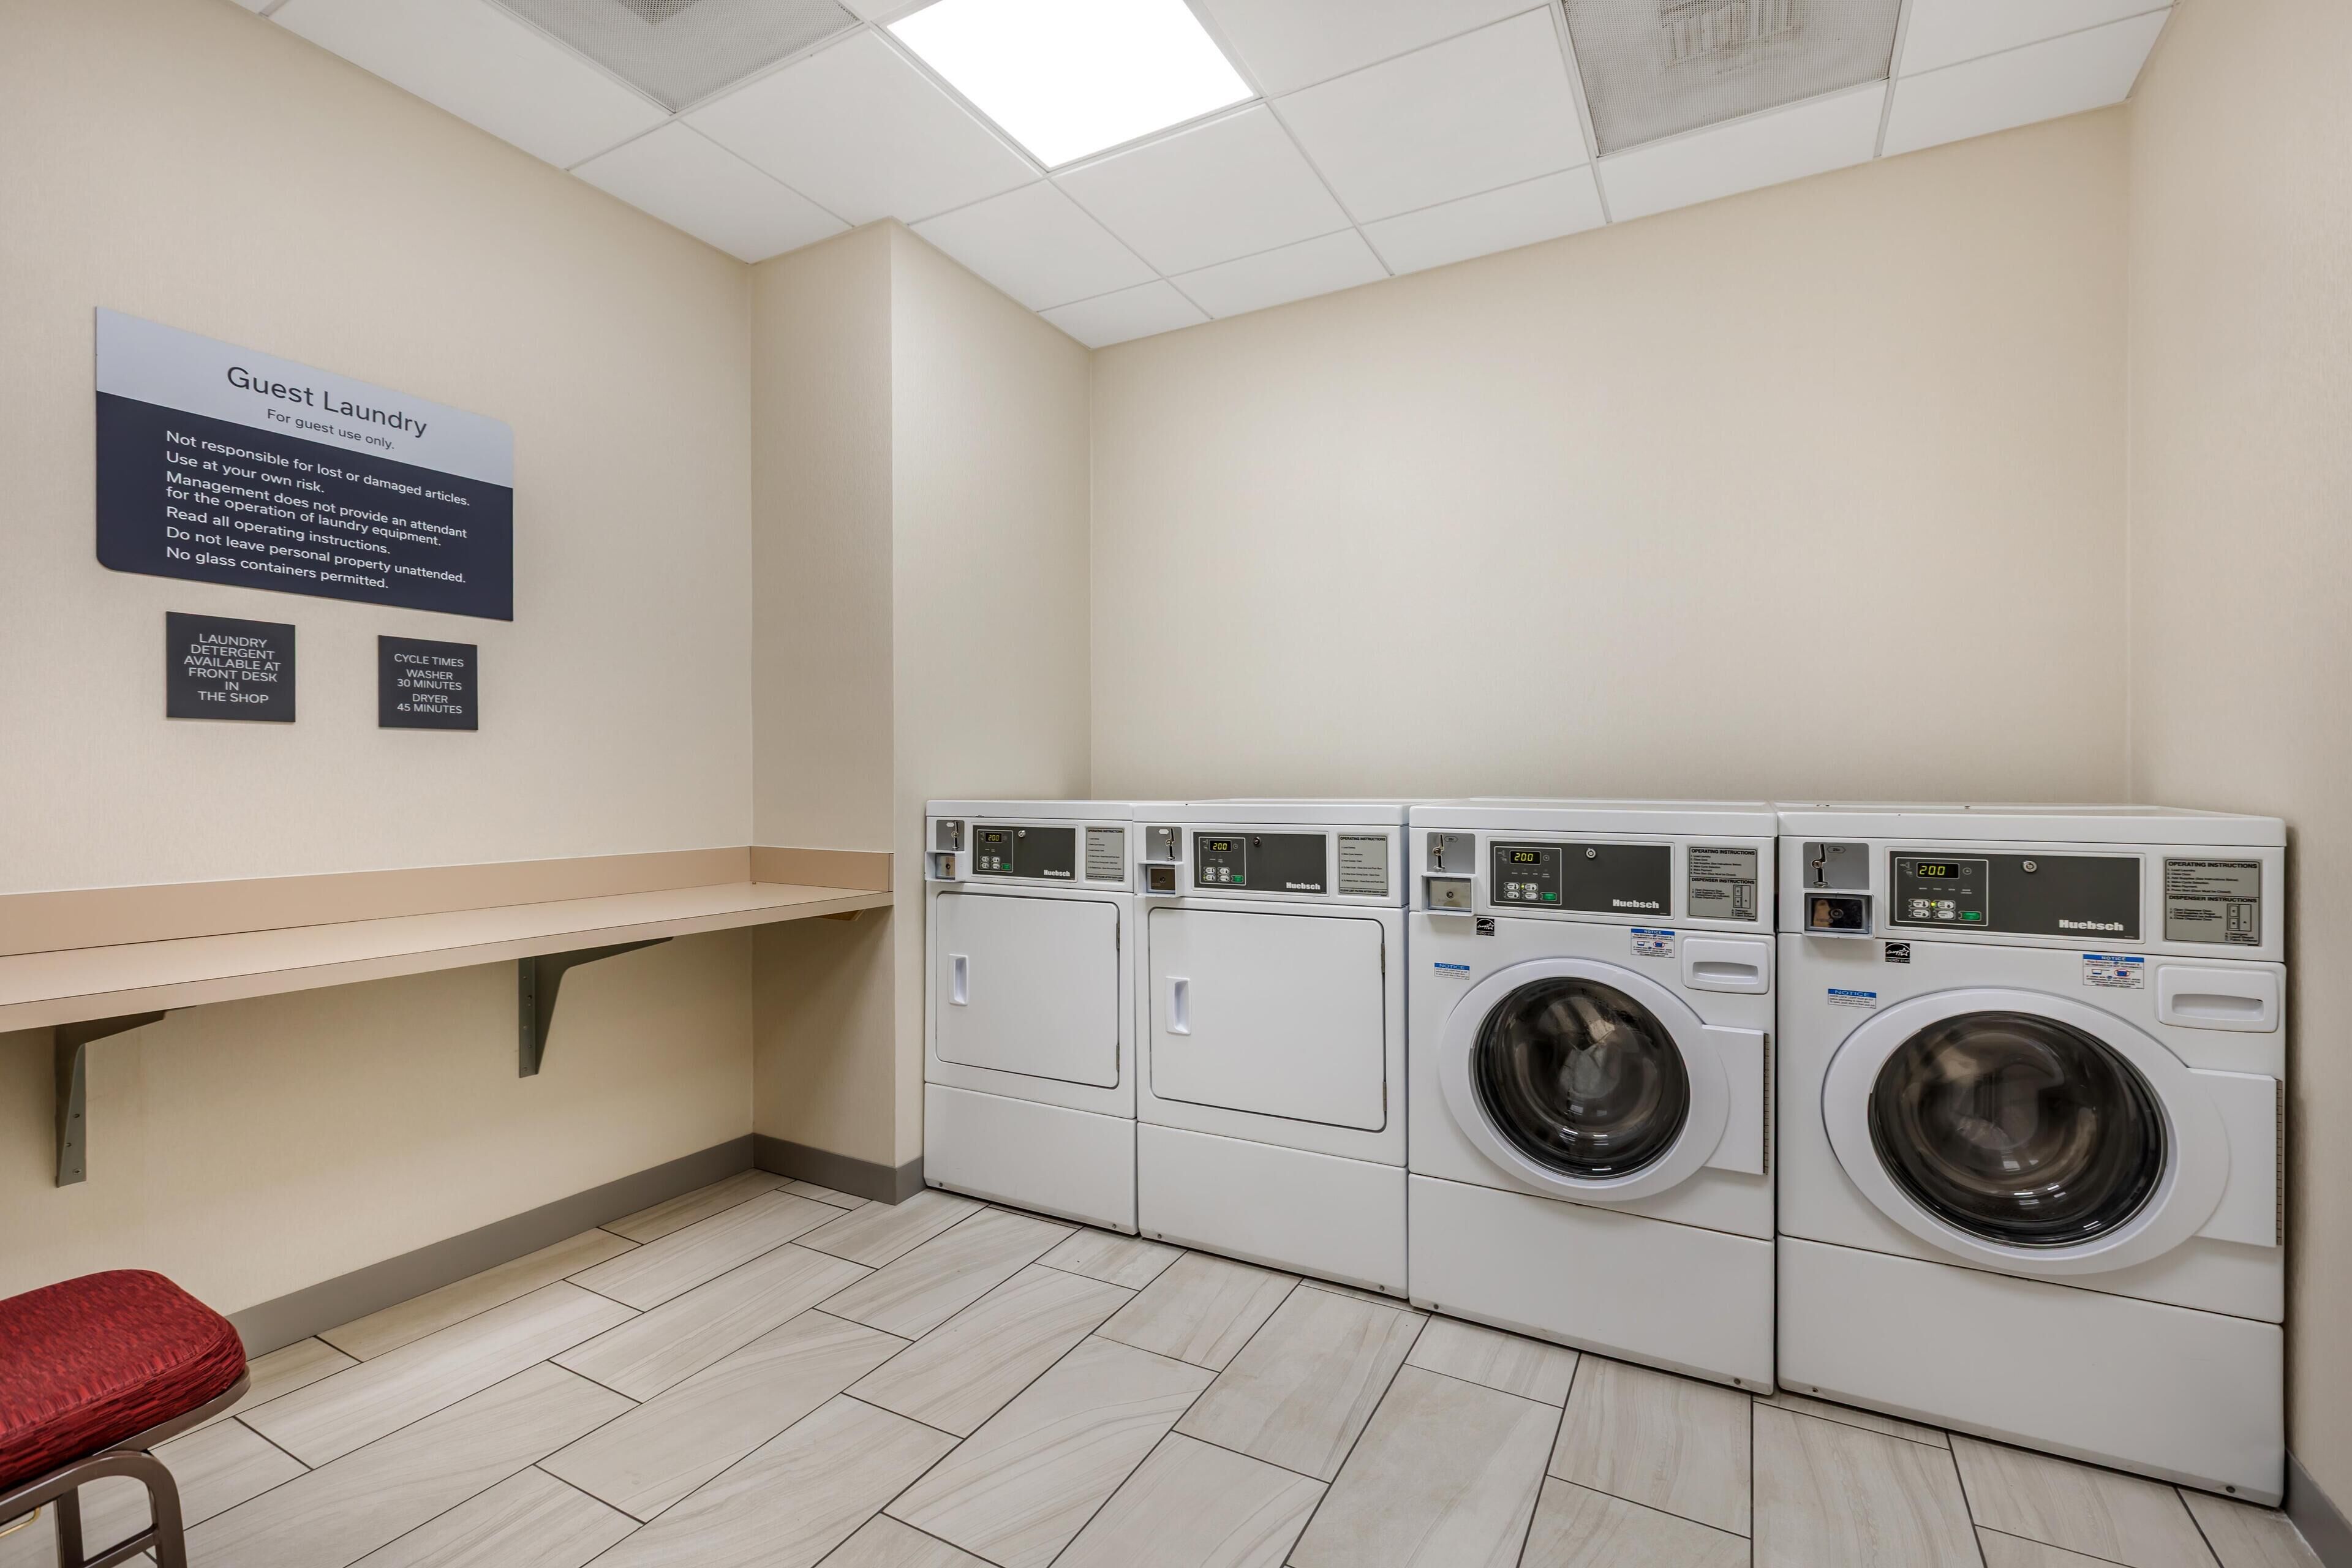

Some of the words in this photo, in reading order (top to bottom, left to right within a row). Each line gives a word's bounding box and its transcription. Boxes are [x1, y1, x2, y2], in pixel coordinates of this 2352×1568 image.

[227, 367, 314, 407] Guest
[324, 391, 427, 438] Laundry
[268, 409, 290, 423] For
[295, 418, 334, 435] guest
[339, 429, 361, 440] use
[366, 435, 394, 450] only.
[167, 431, 197, 448] Not
[202, 440, 288, 467] responsible
[293, 459, 313, 472] for
[317, 464, 342, 479] lost
[346, 473, 360, 481] or
[363, 475, 421, 496] damaged
[425, 489, 470, 506] articles.
[167, 451, 198, 467] Use
[203, 461, 218, 472] at
[222, 465, 257, 478] your
[261, 473, 292, 486] own
[296, 479, 324, 493] risk.
[167, 471, 270, 500] Management
[274, 493, 309, 508] does
[314, 501, 336, 513] not
[340, 507, 388, 523] provide
[392, 517, 407, 527] an
[410, 520, 467, 538] attendant
[166, 486, 189, 500] for
[194, 492, 220, 505] the
[225, 500, 295, 519] operation
[300, 512, 315, 522] of
[319, 514, 368, 534] laundry
[372, 527, 441, 546] equipment.
[167, 507, 207, 523] Read
[213, 516, 229, 527] all
[235, 521, 304, 541] operating
[309, 531, 390, 554] instructions.
[167, 526, 190, 540] Do
[195, 534, 222, 545] not
[227, 535, 265, 552] leave
[270, 545, 330, 562] personal
[334, 556, 391, 573] property
[395, 565, 466, 582] unattended.
[167, 546, 190, 560] No
[195, 552, 236, 567] glass
[240, 560, 317, 578] containers
[320, 571, 388, 588] permitted.
[199, 633, 267, 648] LAUNDRY
[191, 644, 275, 660] DETERGENT
[184, 655, 261, 670] AVAILABLE
[264, 662, 281, 671] AT
[394, 654, 429, 664] CYCLE
[432, 657, 464, 667] TIMES
[189, 668, 238, 679] FRONT
[242, 671, 277, 682] DESK
[406, 669, 453, 680] WASHER
[225, 681, 239, 690] IN
[413, 679, 462, 690] MINUTES
[197, 691, 226, 701] THE
[230, 693, 269, 703] SHOP
[412, 693, 448, 703] DRYER
[413, 704, 462, 714] MINUTES
[1920, 865, 1945, 875] 200
[1613, 899, 1659, 908] Huebsch
[2059, 919, 2124, 931] Huebsch
